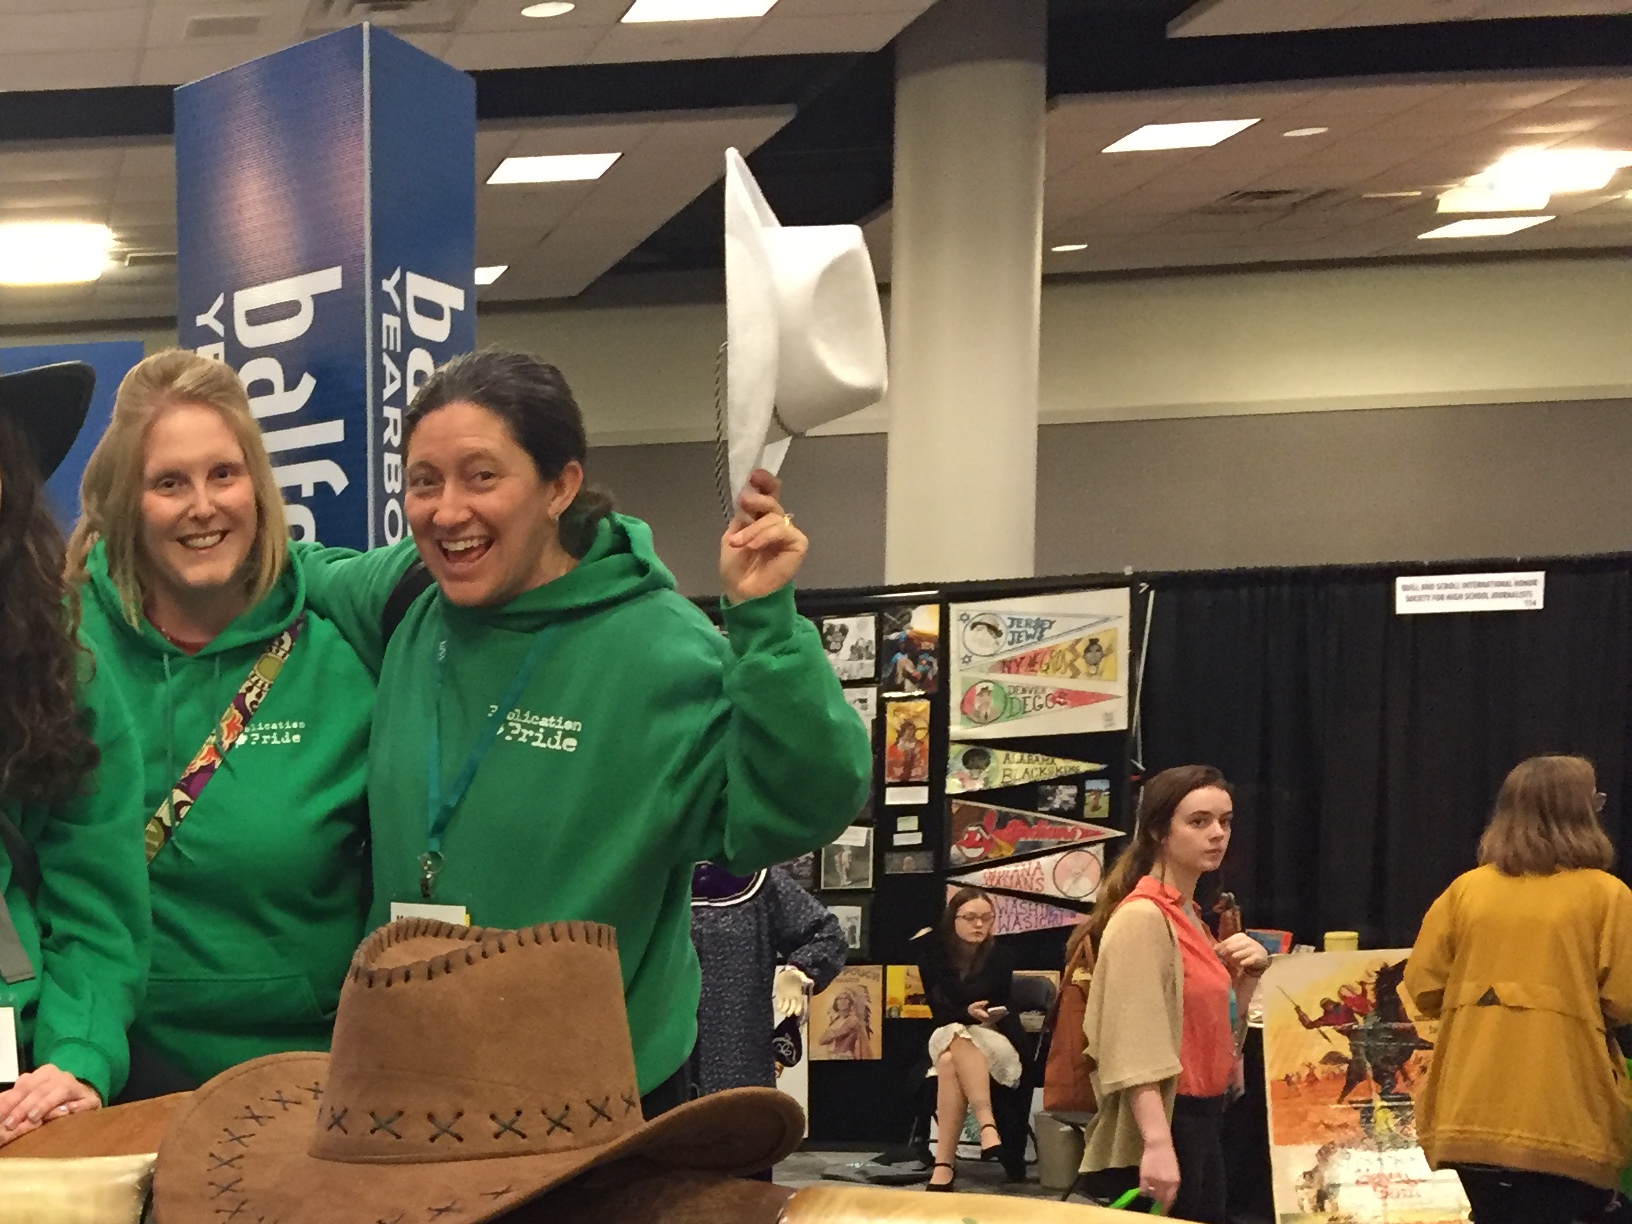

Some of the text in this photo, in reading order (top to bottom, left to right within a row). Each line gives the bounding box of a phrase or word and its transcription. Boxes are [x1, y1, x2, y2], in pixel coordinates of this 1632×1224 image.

[234, 265, 350, 543] balf
[381, 266, 404, 546] YEARBO
[1421, 583, 1435, 591] AND
[1461, 580, 1513, 589] INTERNATIONAL
[1514, 579, 1538, 587] HONOR
[1405, 590, 1533, 603] SOCIETY FOR HIGH SCHOOL JOURNALISTS
[1007, 616, 1057, 630] JERSEY
